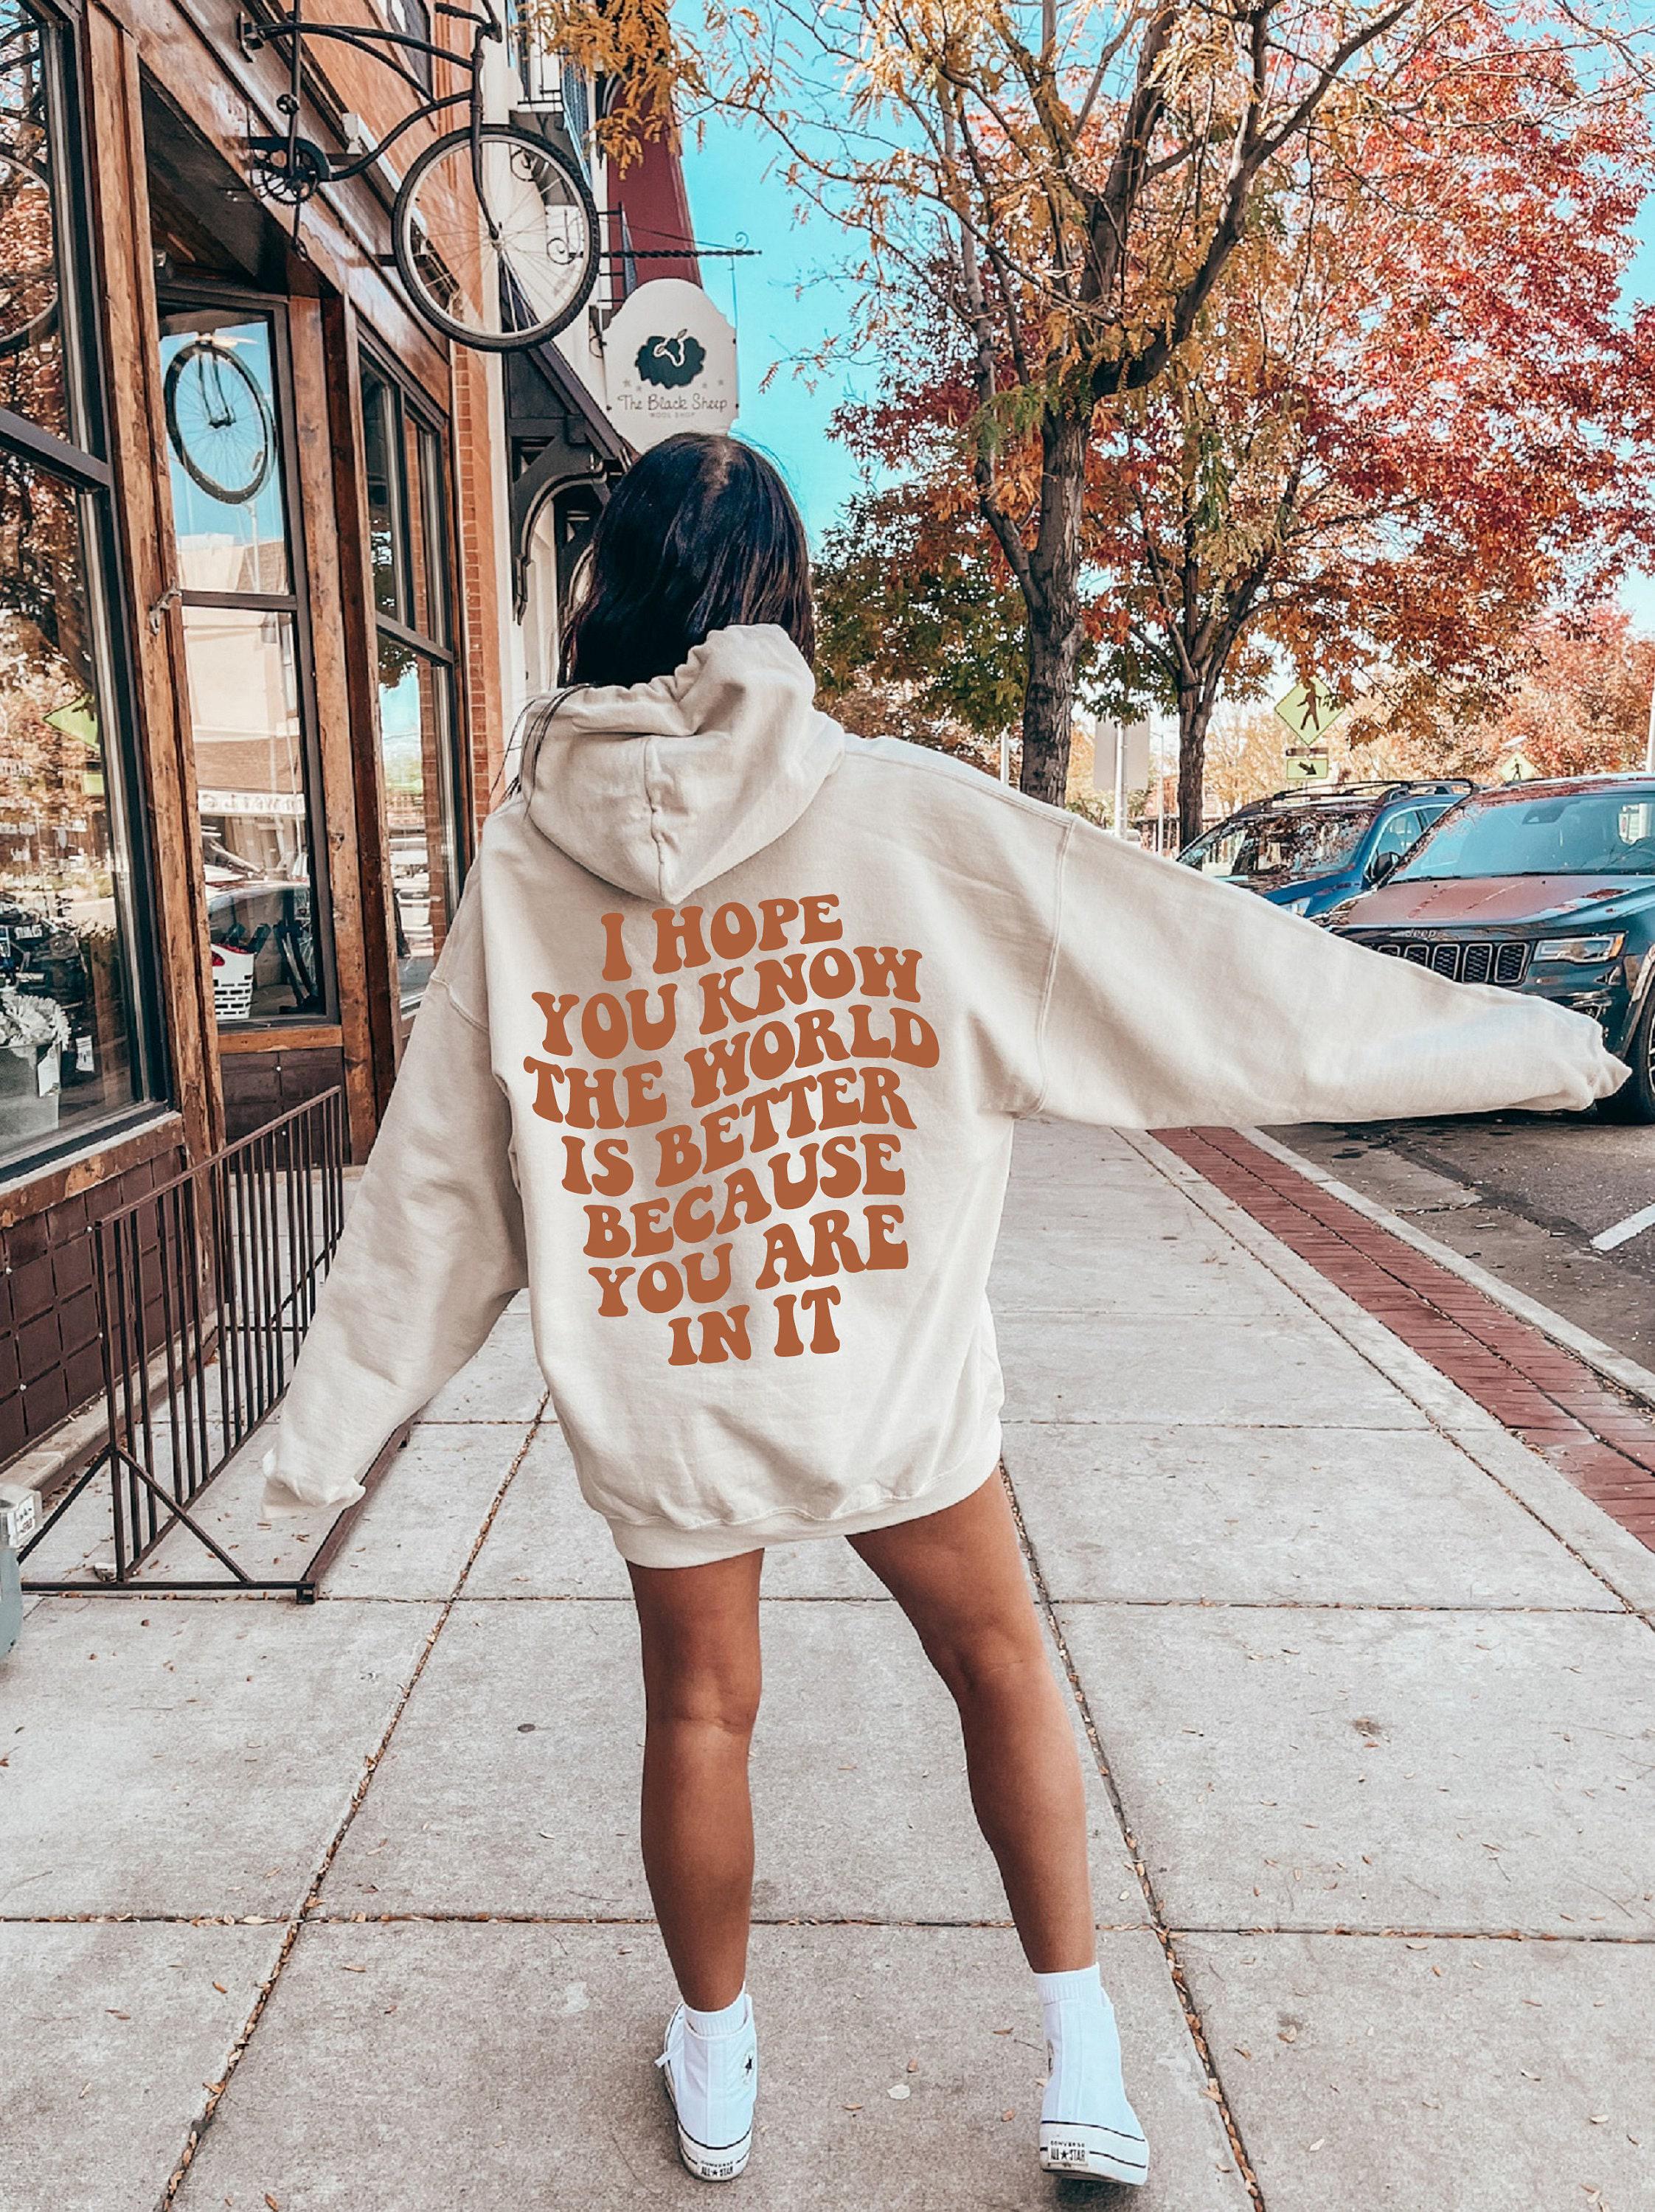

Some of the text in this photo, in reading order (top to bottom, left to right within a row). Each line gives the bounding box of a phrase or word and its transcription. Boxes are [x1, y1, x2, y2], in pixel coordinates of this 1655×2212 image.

[617, 392, 727, 413] The Black Sheep
[602, 894, 842, 981] I HOPE
[1404, 928, 1437, 939] Jeep
[532, 947, 922, 1059] YOU KNOW
[524, 1005, 939, 1129] THE WORLD
[562, 1067, 917, 1196] IS BETTER
[583, 1134, 905, 1258] BECAUSE
[589, 1205, 908, 1316] YOU ARE
[669, 1286, 841, 1366] IN IT
[1050, 2140, 1086, 2148] CONVERSE
